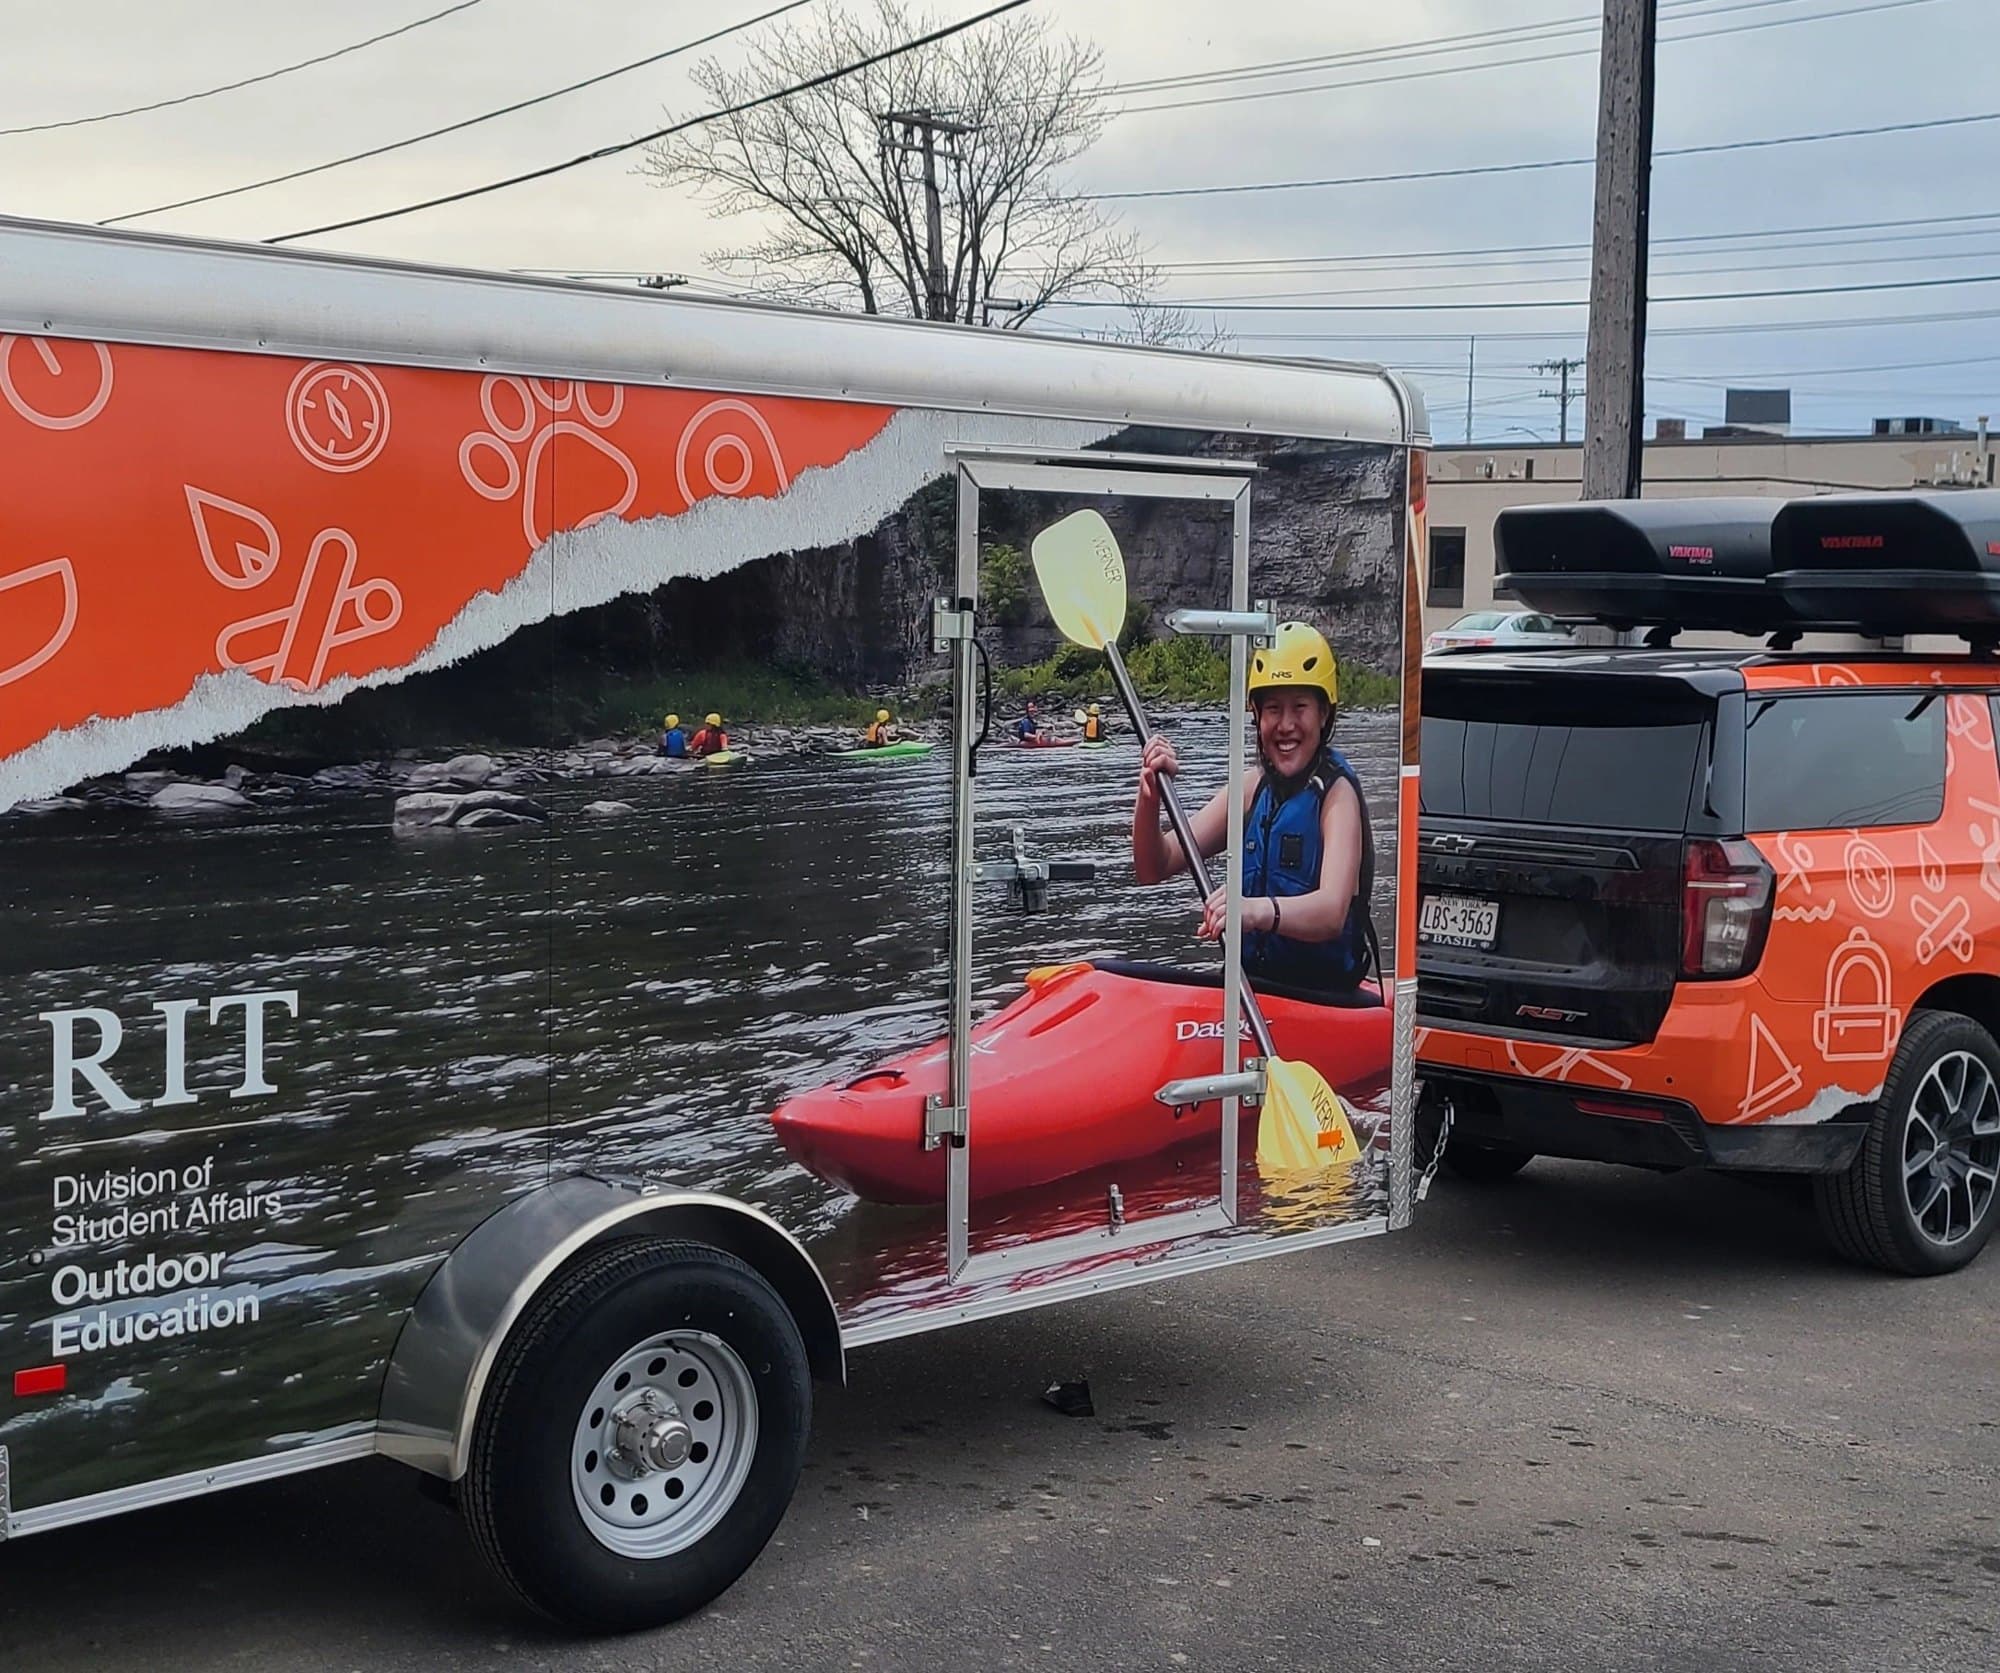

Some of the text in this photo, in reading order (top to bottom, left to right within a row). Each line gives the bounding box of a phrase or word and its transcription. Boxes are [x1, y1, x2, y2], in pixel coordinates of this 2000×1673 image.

[1092, 538, 1122, 585] WERNER
[1668, 545, 1713, 559] YAKIMA
[1821, 535, 1884, 548] YAKIMA
[1271, 671, 1293, 680] NRS
[1432, 933, 1477, 948] BASIL
[1515, 1004, 1589, 1022] RST
[38, 989, 299, 1121] RIT
[53, 1155, 214, 1209] Division of
[51, 1189, 282, 1247] Student Affairs
[51, 1251, 226, 1306] Outdoor
[52, 1293, 260, 1358] Education
